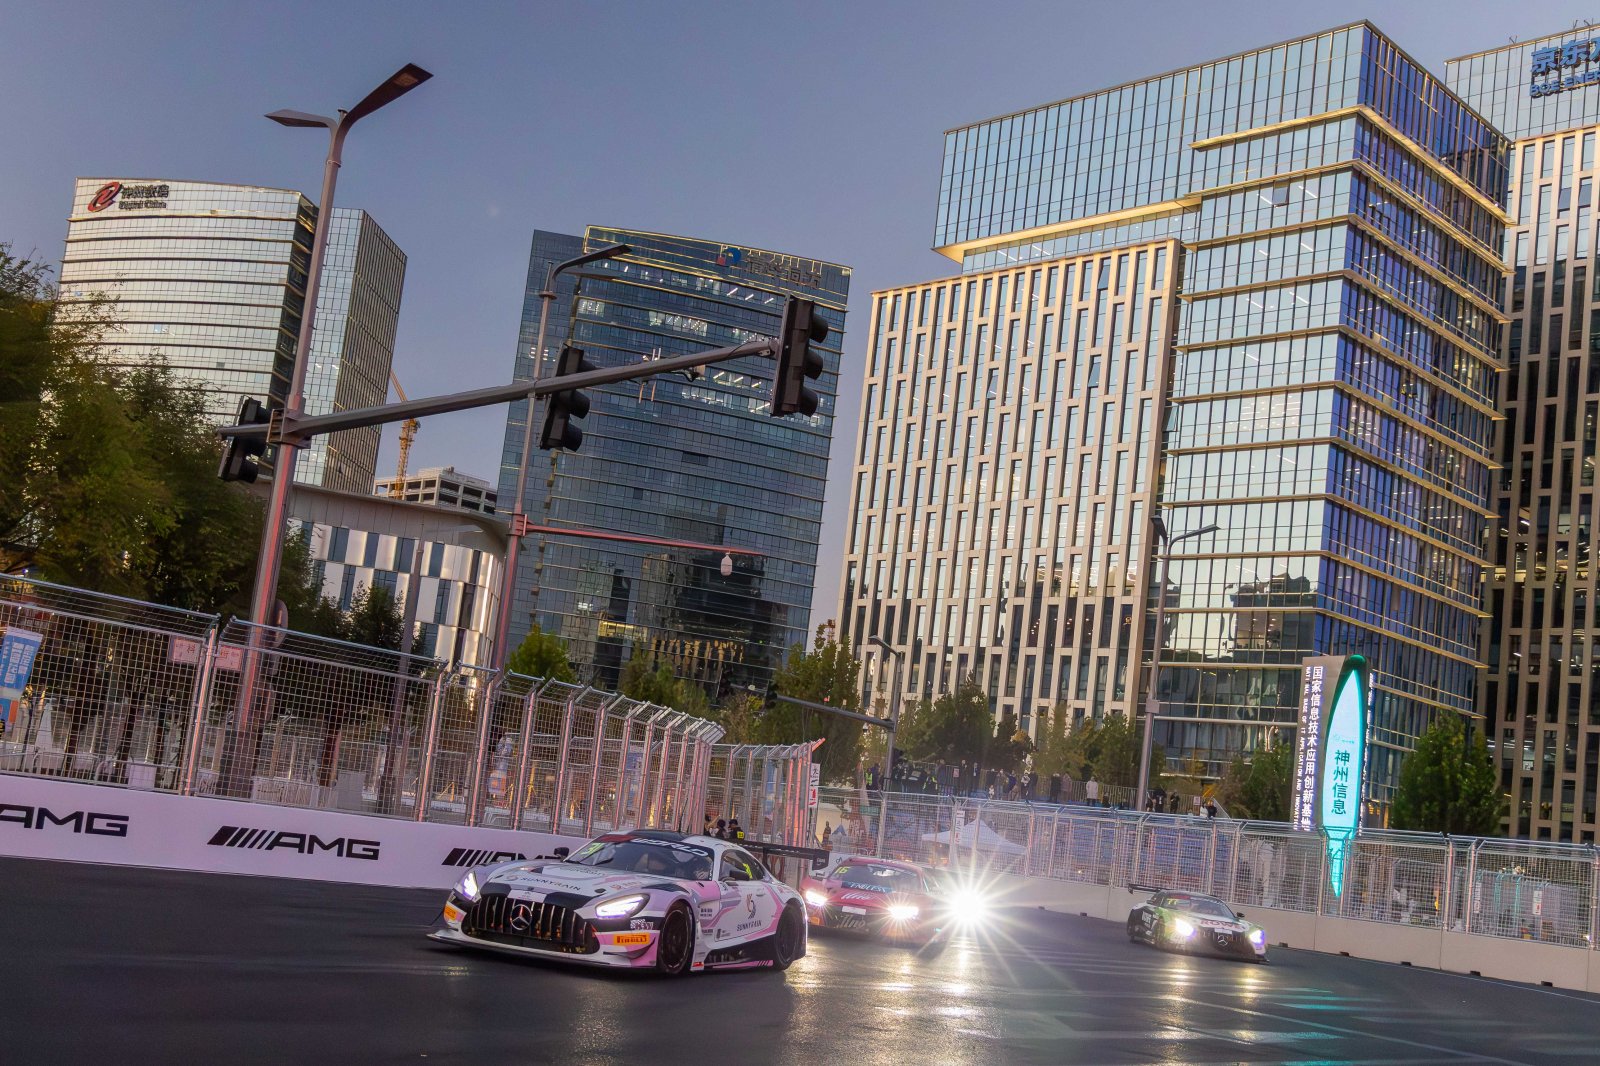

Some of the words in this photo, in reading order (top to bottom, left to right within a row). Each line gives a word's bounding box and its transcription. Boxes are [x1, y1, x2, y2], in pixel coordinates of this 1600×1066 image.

[1530, 80, 1560, 97] BOE
[1331, 749, 1351, 815] 神州信息
[0, 803, 129, 837] AMG
[264, 831, 381, 861] AMG
